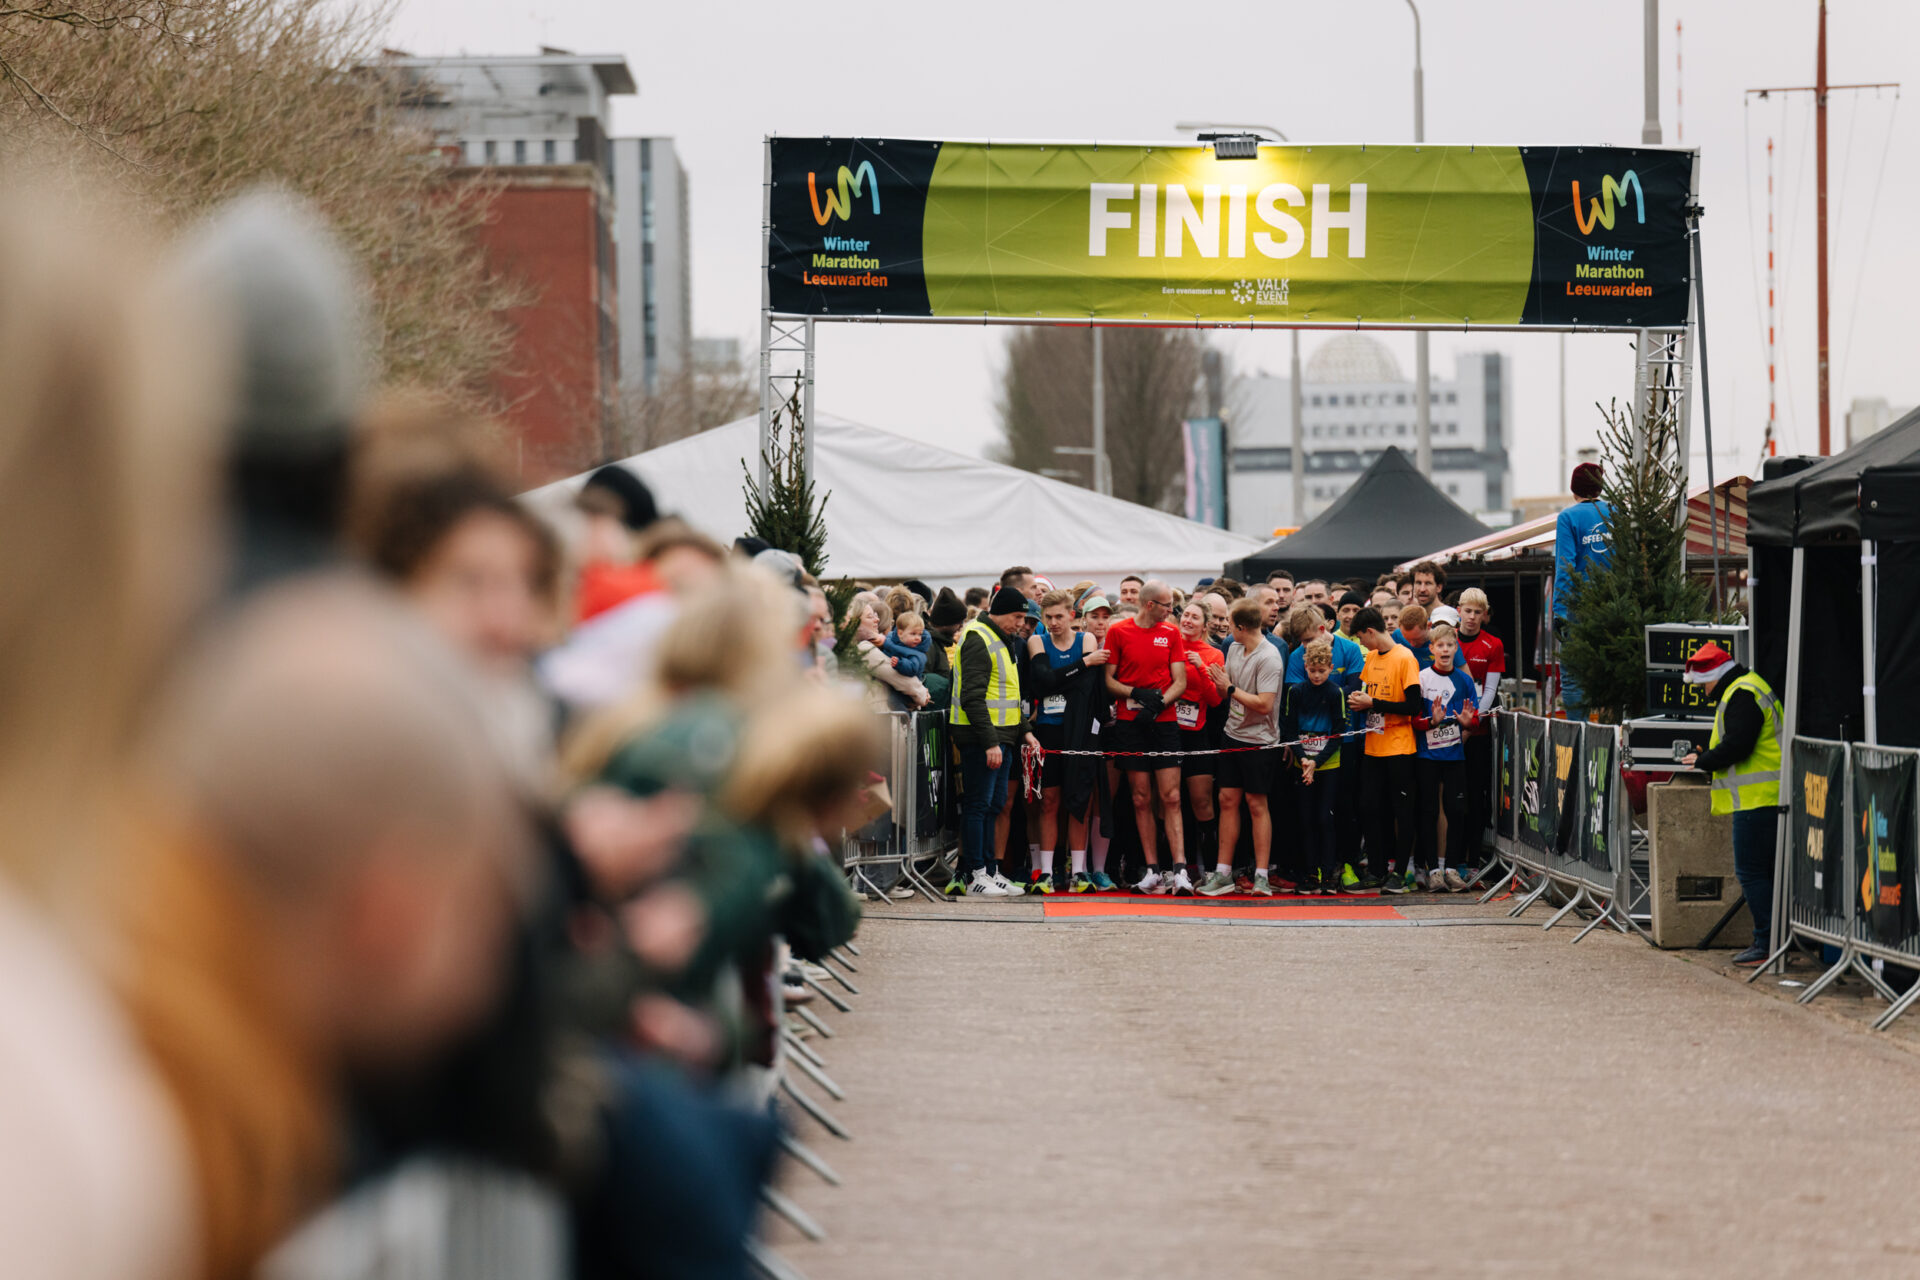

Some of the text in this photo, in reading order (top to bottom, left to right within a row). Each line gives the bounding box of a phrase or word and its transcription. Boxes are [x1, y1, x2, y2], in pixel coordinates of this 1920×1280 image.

[1089, 182, 1368, 259] FINISH
[823, 236, 870, 251] Winter
[1587, 246, 1634, 261] Winter
[812, 254, 880, 269] Marathon
[803, 271, 888, 287] Leeuwarden
[1576, 264, 1644, 279] Marathon
[1162, 286, 1175, 295] Een
[1176, 287, 1213, 295] evenement
[1256, 278, 1290, 291] VALK
[1566, 281, 1652, 297] Leeuwarden
[1256, 290, 1289, 301] EVENT
[1432, 728, 1454, 739] 6093
